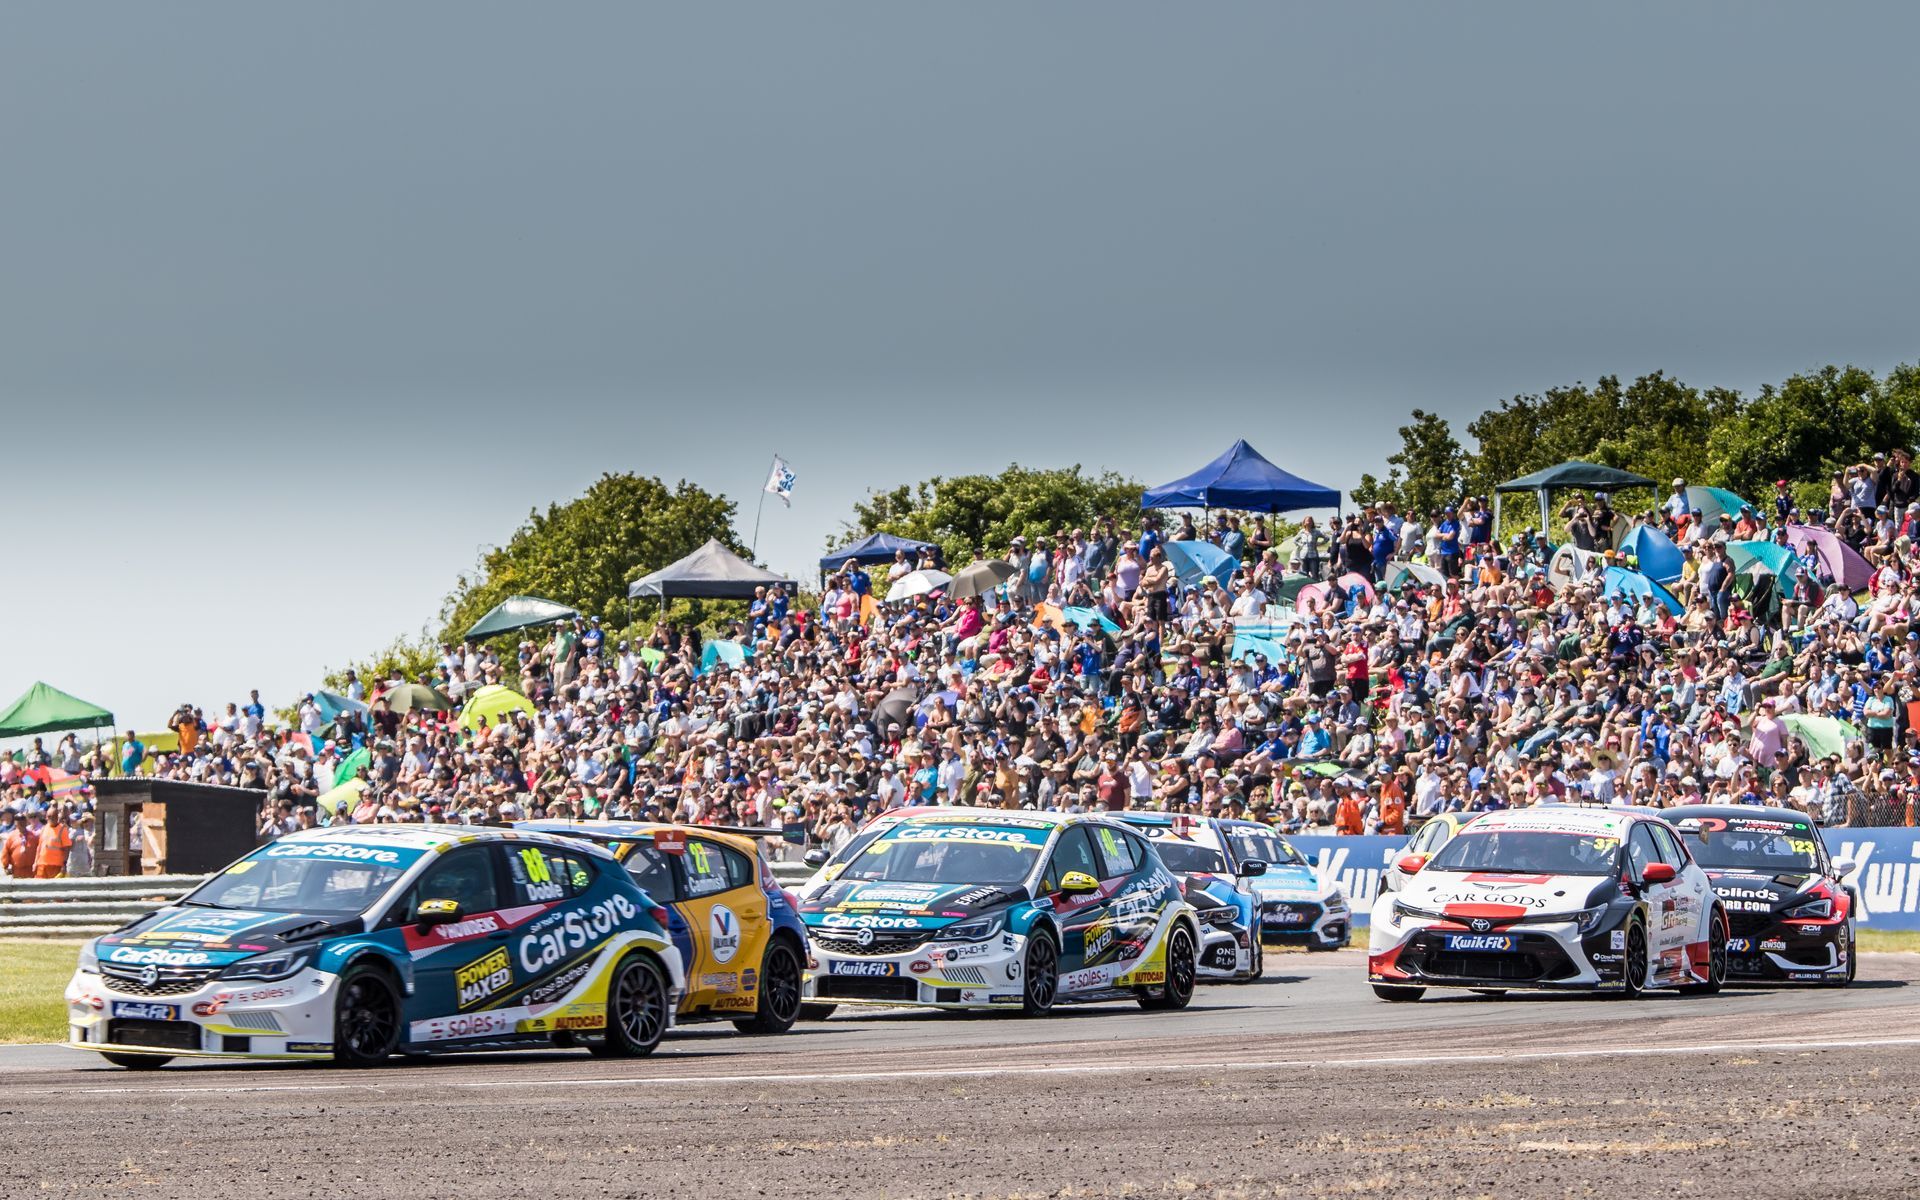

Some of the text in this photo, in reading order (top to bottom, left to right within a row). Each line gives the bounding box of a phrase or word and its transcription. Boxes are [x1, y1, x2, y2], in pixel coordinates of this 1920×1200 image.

[897, 828, 1027, 843] CarStore
[267, 844, 399, 863] CarStore
[1788, 840, 1815, 853] 123
[521, 848, 550, 882] 88
[526, 881, 564, 901] Doble
[954, 885, 1001, 905] EPIMAX
[1712, 887, 1780, 901] blinds
[1433, 894, 1547, 908] CAR GODS
[822, 912, 918, 928] CarStore
[522, 894, 637, 973] CarStore
[1085, 930, 1112, 960] MAXED
[1760, 941, 1786, 950] JEWSON
[110, 946, 209, 964] CarStore
[1216, 957, 1235, 965] PLM
[460, 952, 508, 988] POWER
[1134, 971, 1164, 983] AUTOCAR
[460, 968, 510, 1004] MAXED
[714, 997, 755, 1009] AUTOCAR
[554, 1015, 604, 1029] AUTOCAR
